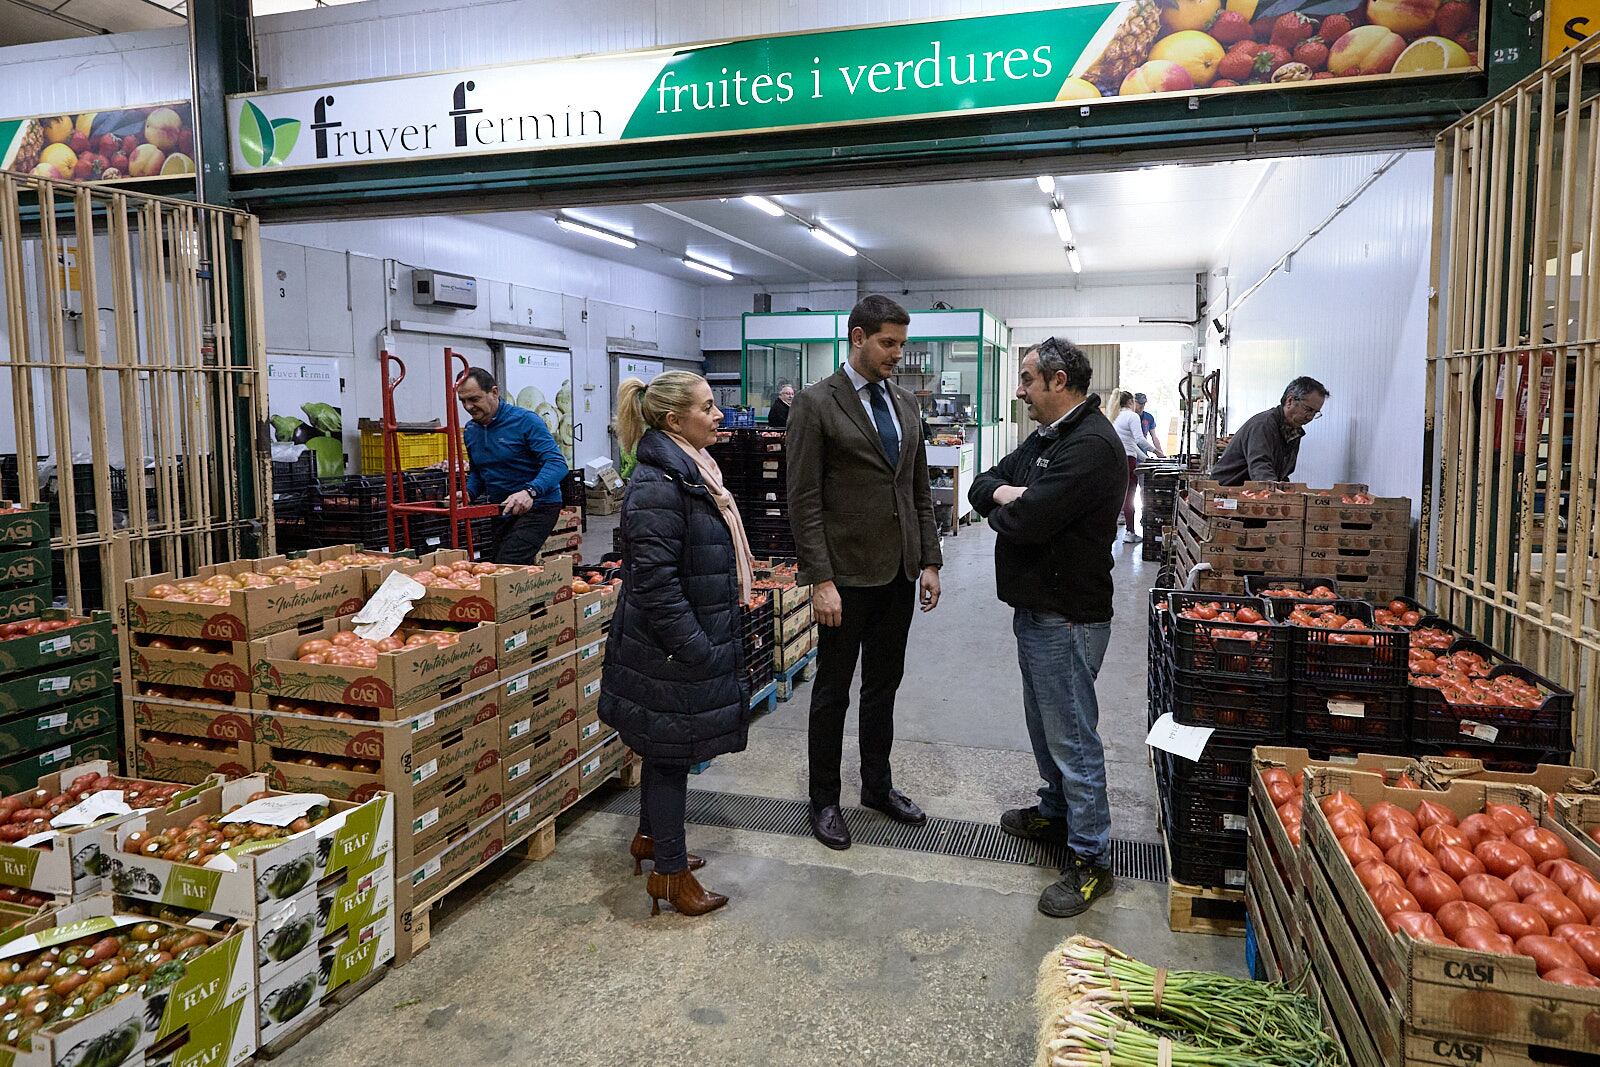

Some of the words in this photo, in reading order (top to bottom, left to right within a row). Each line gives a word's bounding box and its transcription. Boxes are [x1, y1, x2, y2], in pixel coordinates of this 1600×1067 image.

[1494, 47, 1519, 63] 25
[656, 67, 794, 114] fruites
[811, 56, 823, 99] i
[838, 40, 1053, 95] verdures
[310, 95, 437, 159] fruver
[449, 80, 605, 147] fermin
[279, 287, 286, 298] 3
[1314, 498, 1330, 506] CASI
[1217, 521, 1231, 529] CASI
[1313, 524, 1329, 532] CASI
[1310, 551, 1327, 559] CASI
[274, 584, 340, 613] Naturalmente
[455, 607, 481, 619] CASI
[207, 623, 232, 638] CASI
[210, 673, 235, 688] CASI
[349, 686, 378, 703] CASI
[59, 709, 100, 735] CASI
[213, 724, 238, 738] CASI
[352, 740, 381, 757] CASI
[343, 832, 369, 855] RAF
[4, 862, 26, 876] RAF
[182, 883, 207, 899] RAF
[343, 891, 369, 913] RAF
[345, 944, 371, 969] RAF
[1443, 960, 1494, 984] CASI
[184, 977, 220, 1011] RAF
[1433, 1040, 1483, 1063] CASI
